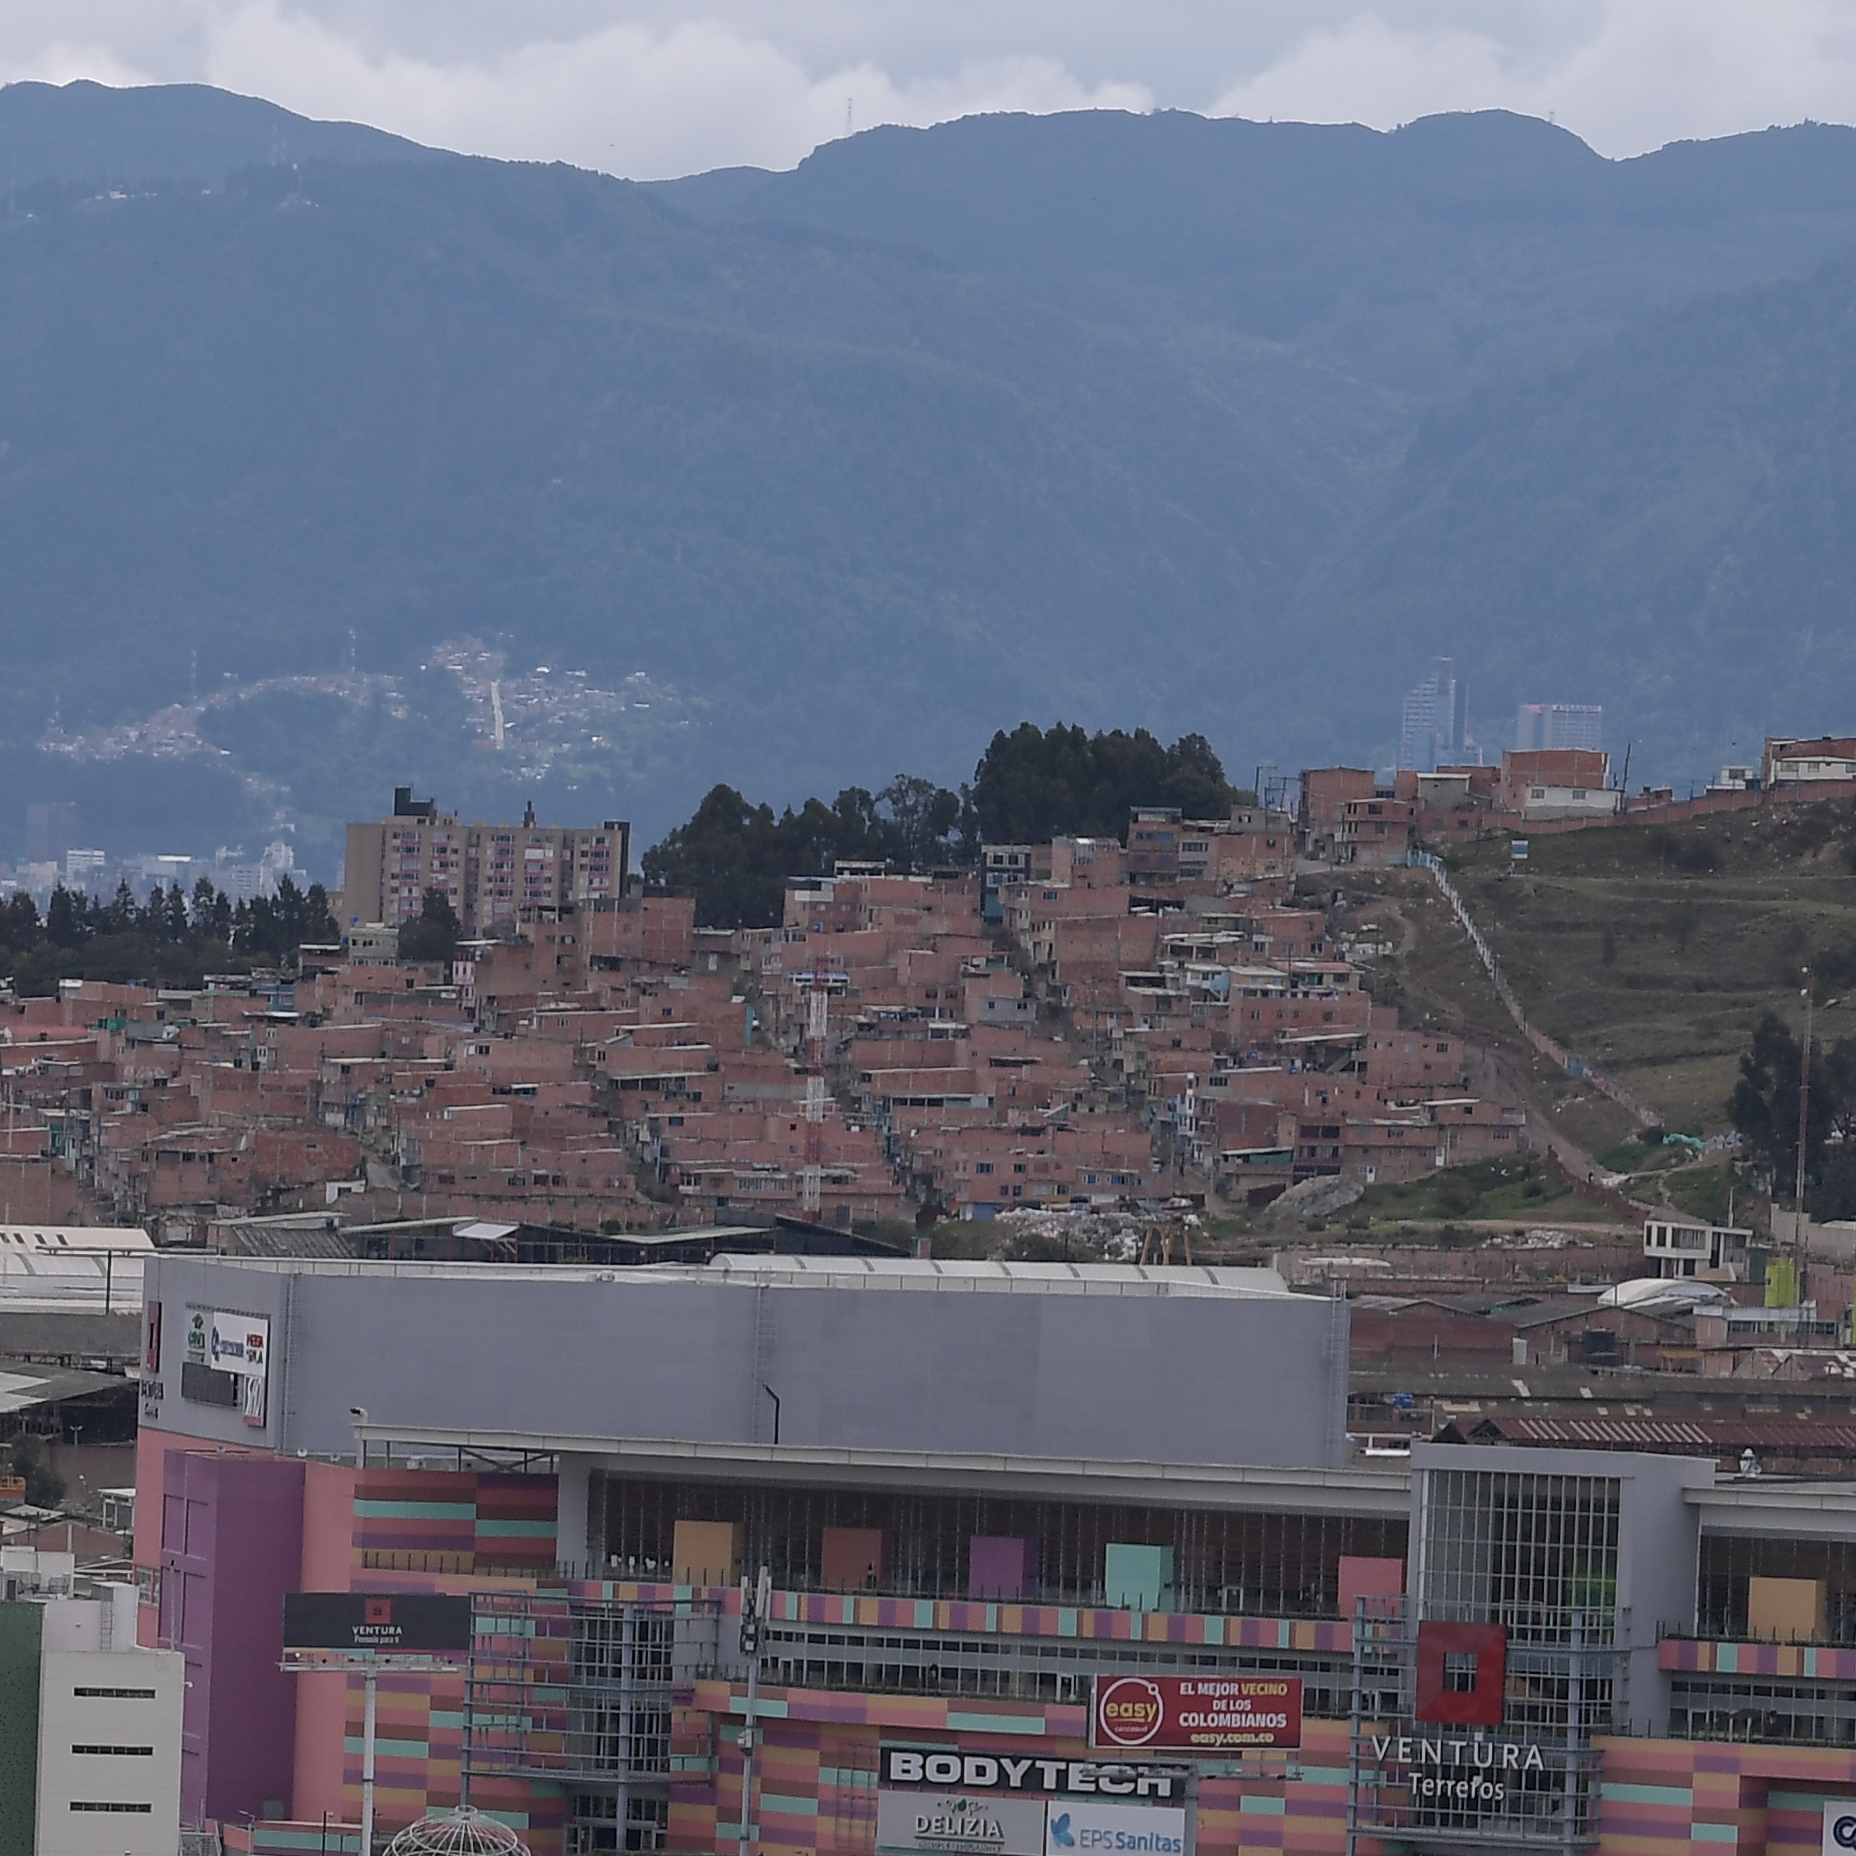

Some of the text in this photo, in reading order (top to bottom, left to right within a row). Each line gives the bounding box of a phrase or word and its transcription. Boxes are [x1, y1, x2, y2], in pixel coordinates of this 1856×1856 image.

[351, 1625, 403, 1635] VENTURA
[1180, 1682, 1288, 1697] EL MEJOR VECINO
[1105, 1701, 1158, 1722] easy
[1212, 1699, 1252, 1711] DE LOS
[1178, 1712, 1287, 1728] COLOMBIANOS
[1190, 1732, 1275, 1746] easy.com.co
[1371, 1734, 1545, 1771] VENTURA
[890, 1751, 1172, 1798] BODYTECH
[1407, 1771, 1505, 1800] Terreros
[915, 1815, 1005, 1839] DELIZIA
[1079, 1829, 1182, 1852] EPS Sanitas
